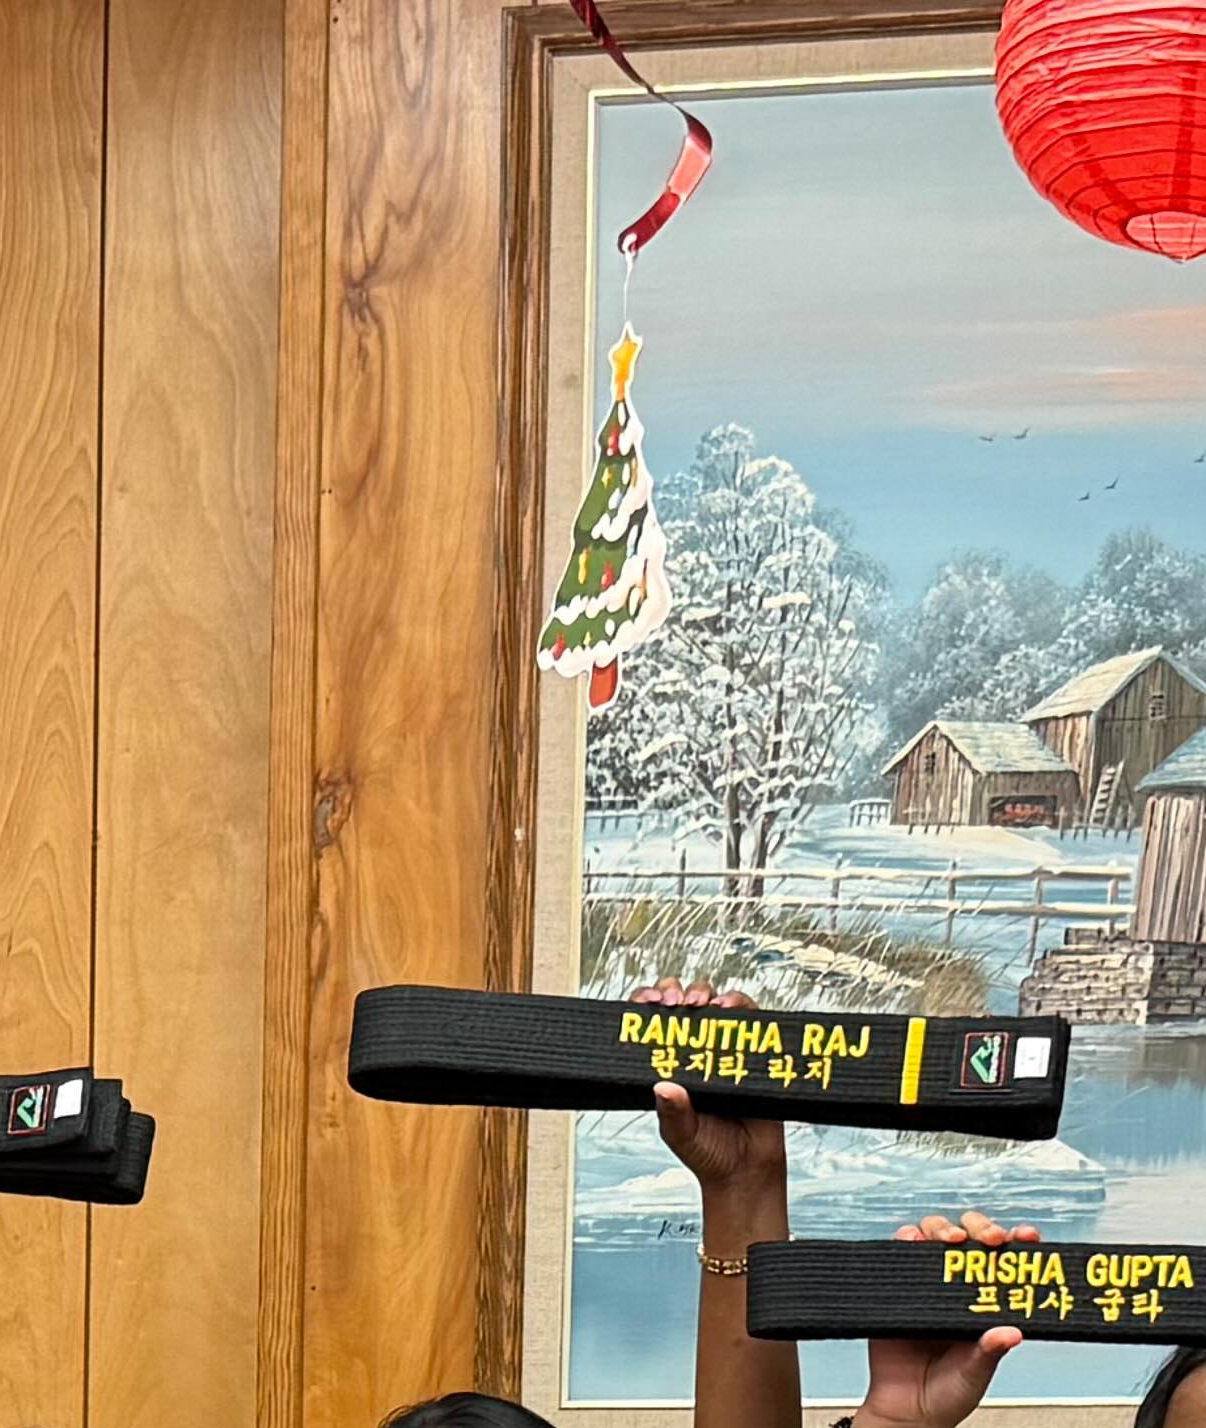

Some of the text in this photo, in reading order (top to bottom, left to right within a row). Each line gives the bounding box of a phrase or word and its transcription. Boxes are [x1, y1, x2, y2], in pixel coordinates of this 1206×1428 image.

[618, 1012, 872, 1060] RANJITHA RAJ
[650, 1047, 832, 1090] 란지타 라지
[942, 1249, 1196, 1289] PRISHA GUPTA
[968, 1285, 1165, 1324] 프리샤 굽타
